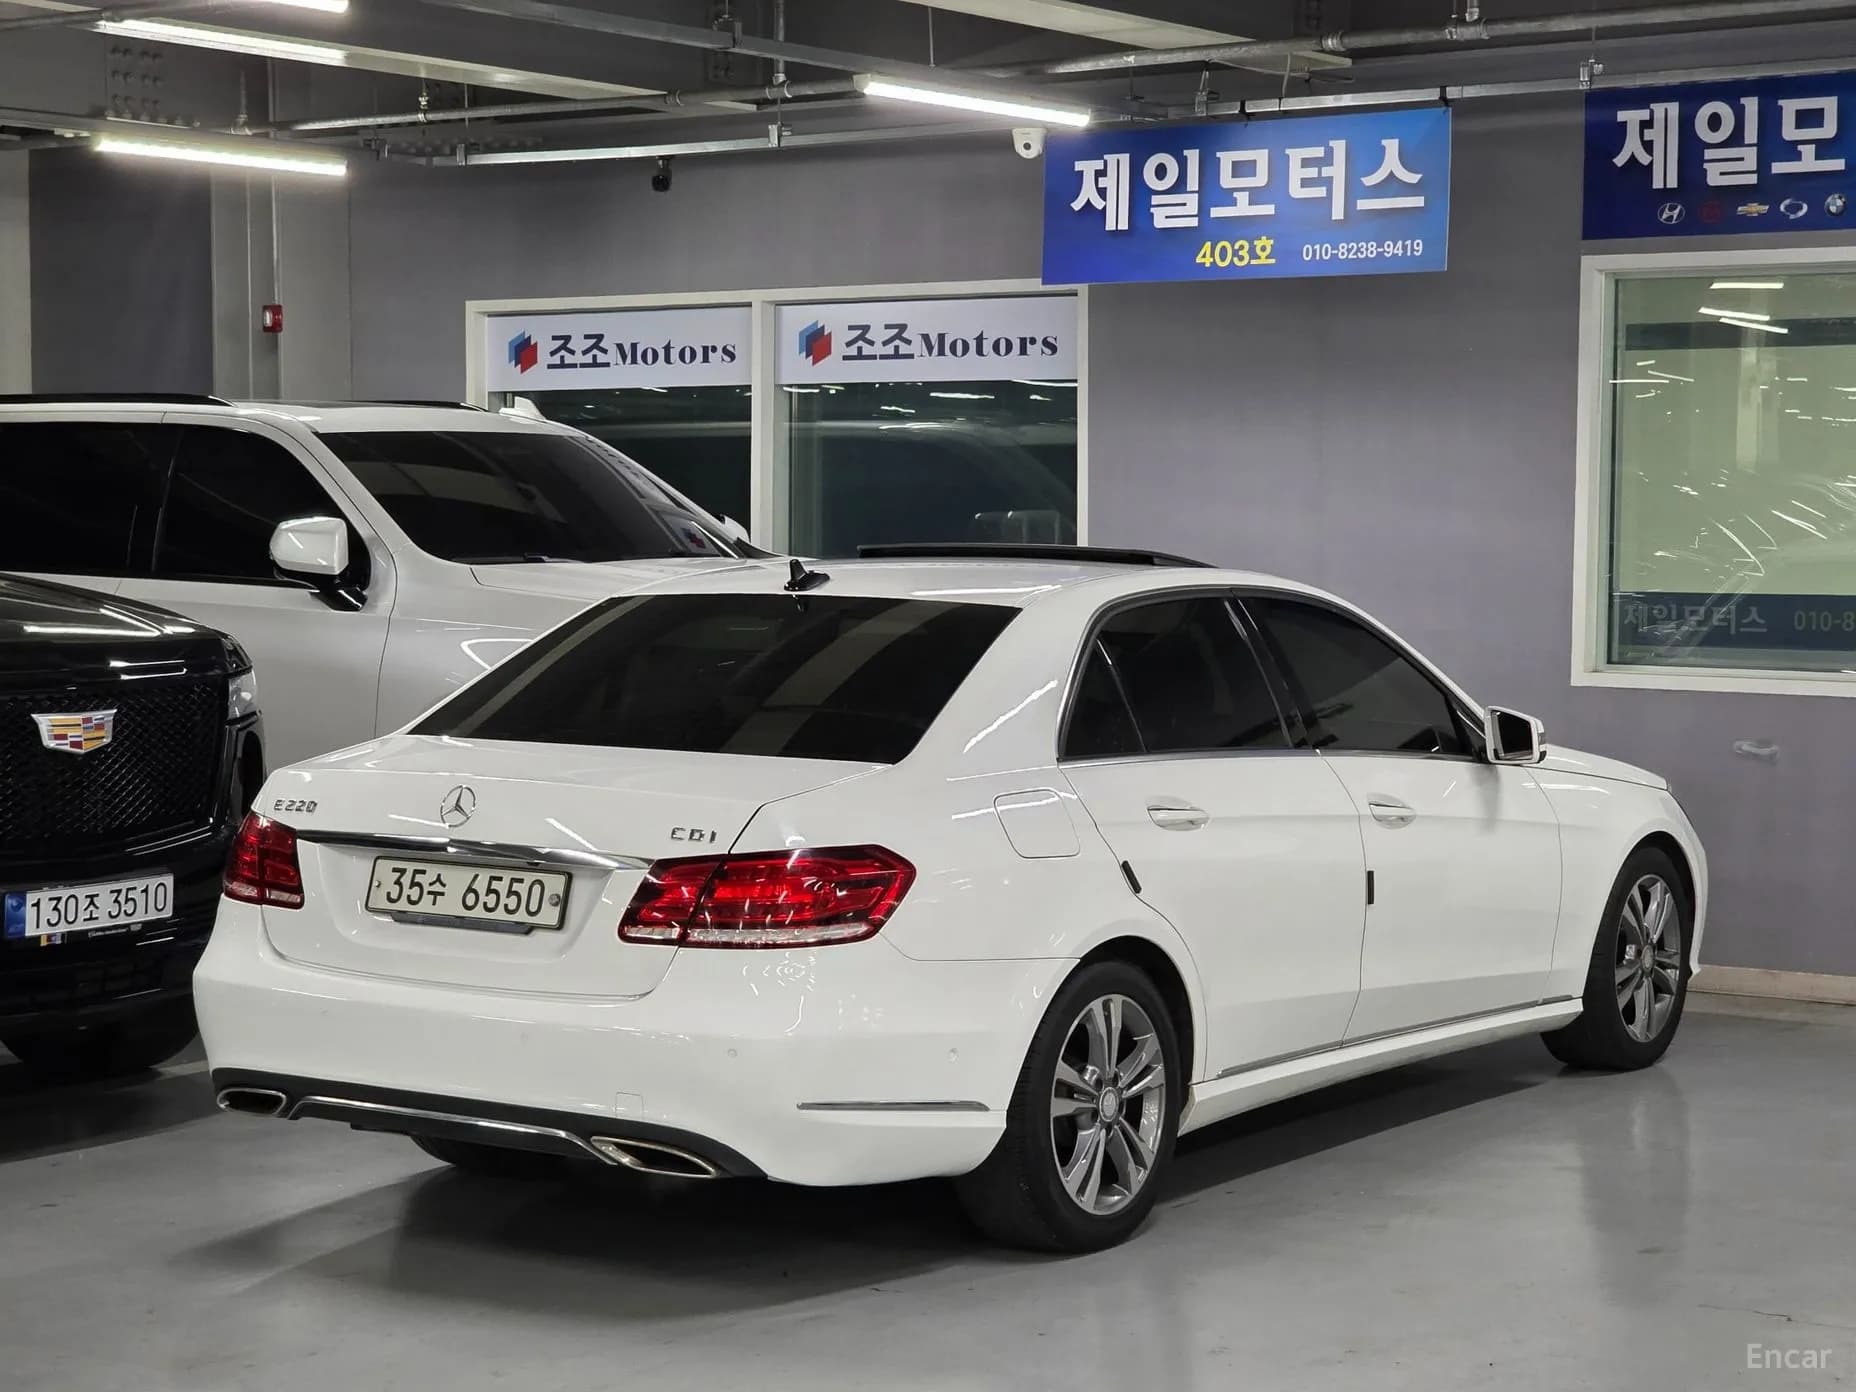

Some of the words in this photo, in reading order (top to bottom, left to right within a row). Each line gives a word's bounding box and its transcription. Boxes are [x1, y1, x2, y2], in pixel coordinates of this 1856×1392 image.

[1612, 95, 1846, 189] 제일모
[1070, 138, 1425, 231] 제일모터스
[1195, 235, 1277, 268] 403호
[1302, 239, 1423, 262] 010-8238-9419
[546, 333, 737, 371] 조조Motors
[841, 322, 1059, 362] 조조Motors
[1623, 602, 1768, 635] 제일모터스
[670, 826, 718, 844] CDI
[31, 893, 100, 929] 130조
[108, 882, 168, 919] 3510
[386, 866, 447, 906] 35수
[461, 873, 546, 917] 6550
